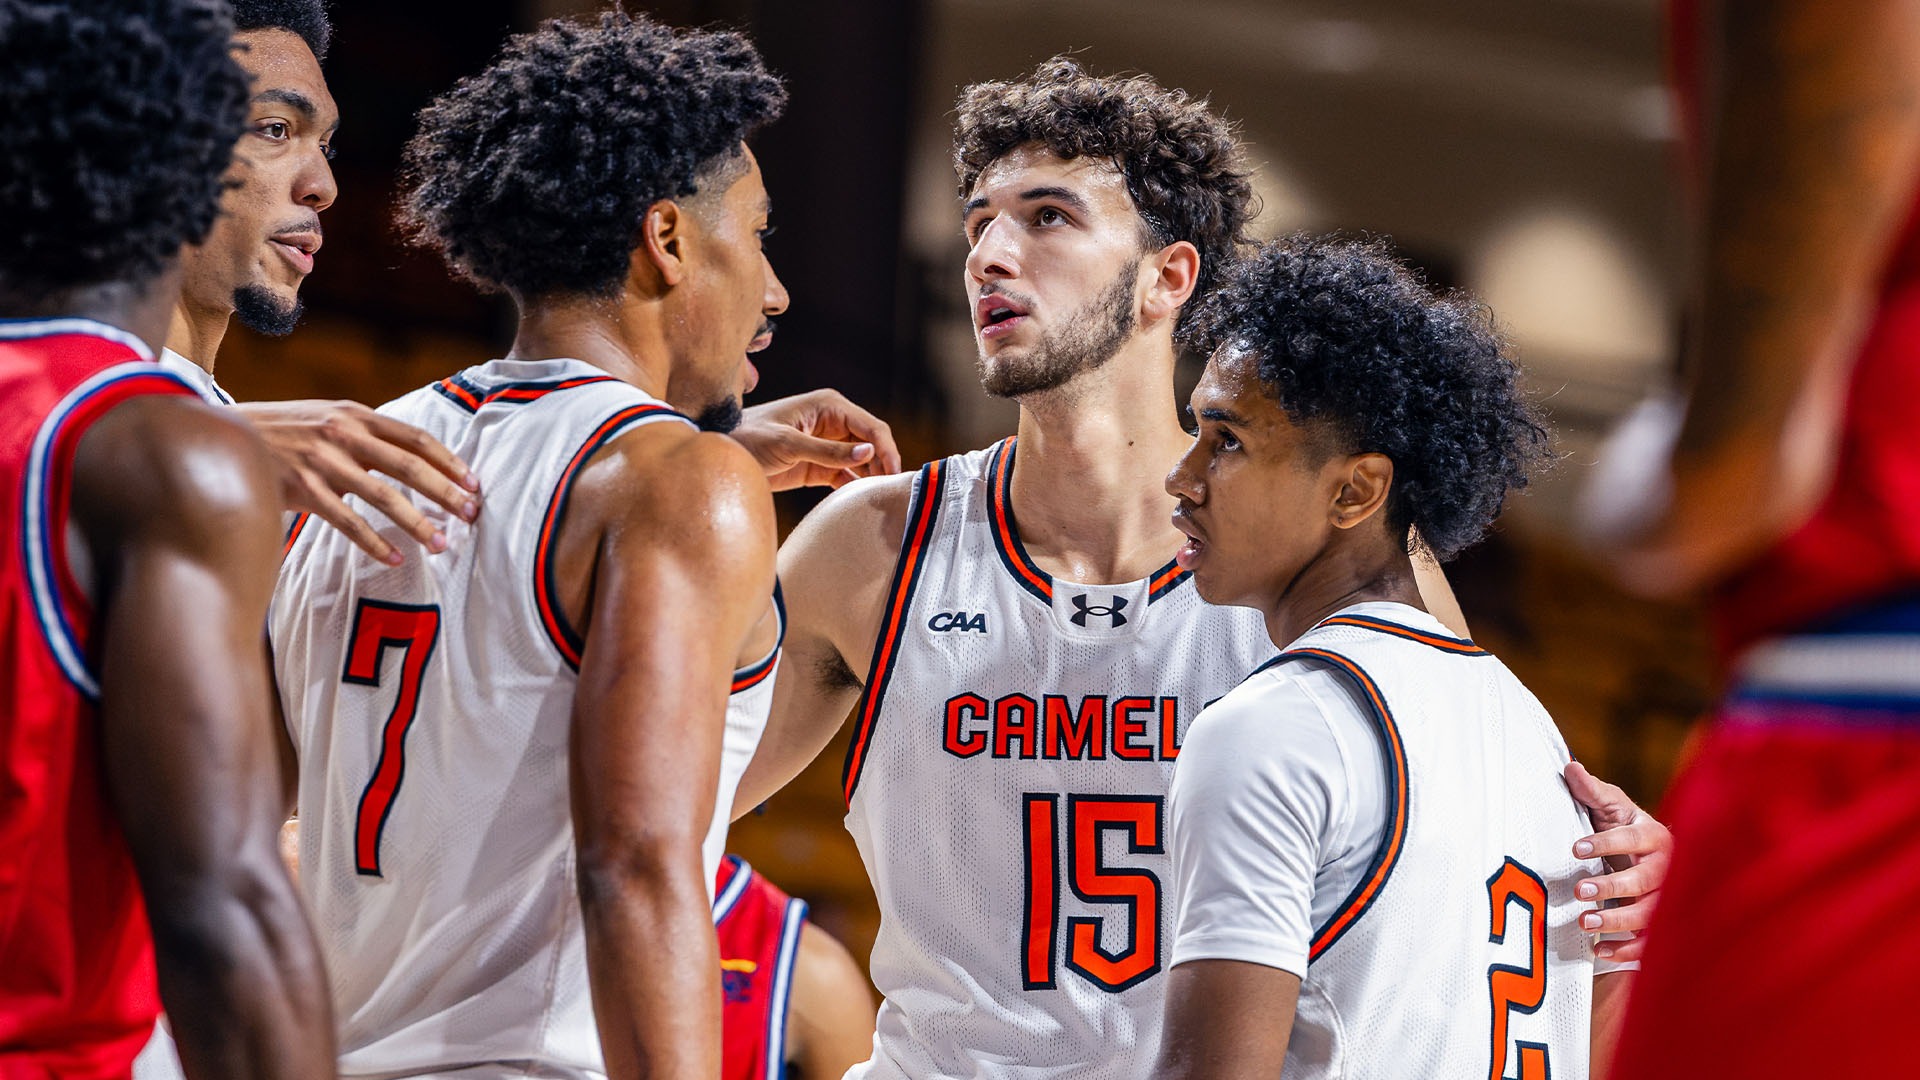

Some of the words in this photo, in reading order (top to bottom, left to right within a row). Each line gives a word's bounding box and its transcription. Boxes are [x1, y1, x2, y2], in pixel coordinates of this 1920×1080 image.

[928, 611, 987, 633] CAA
[341, 597, 441, 877] 7
[942, 691, 1226, 762] CAMEL
[1021, 792, 1165, 993] 15
[1485, 855, 1551, 1080] 2
